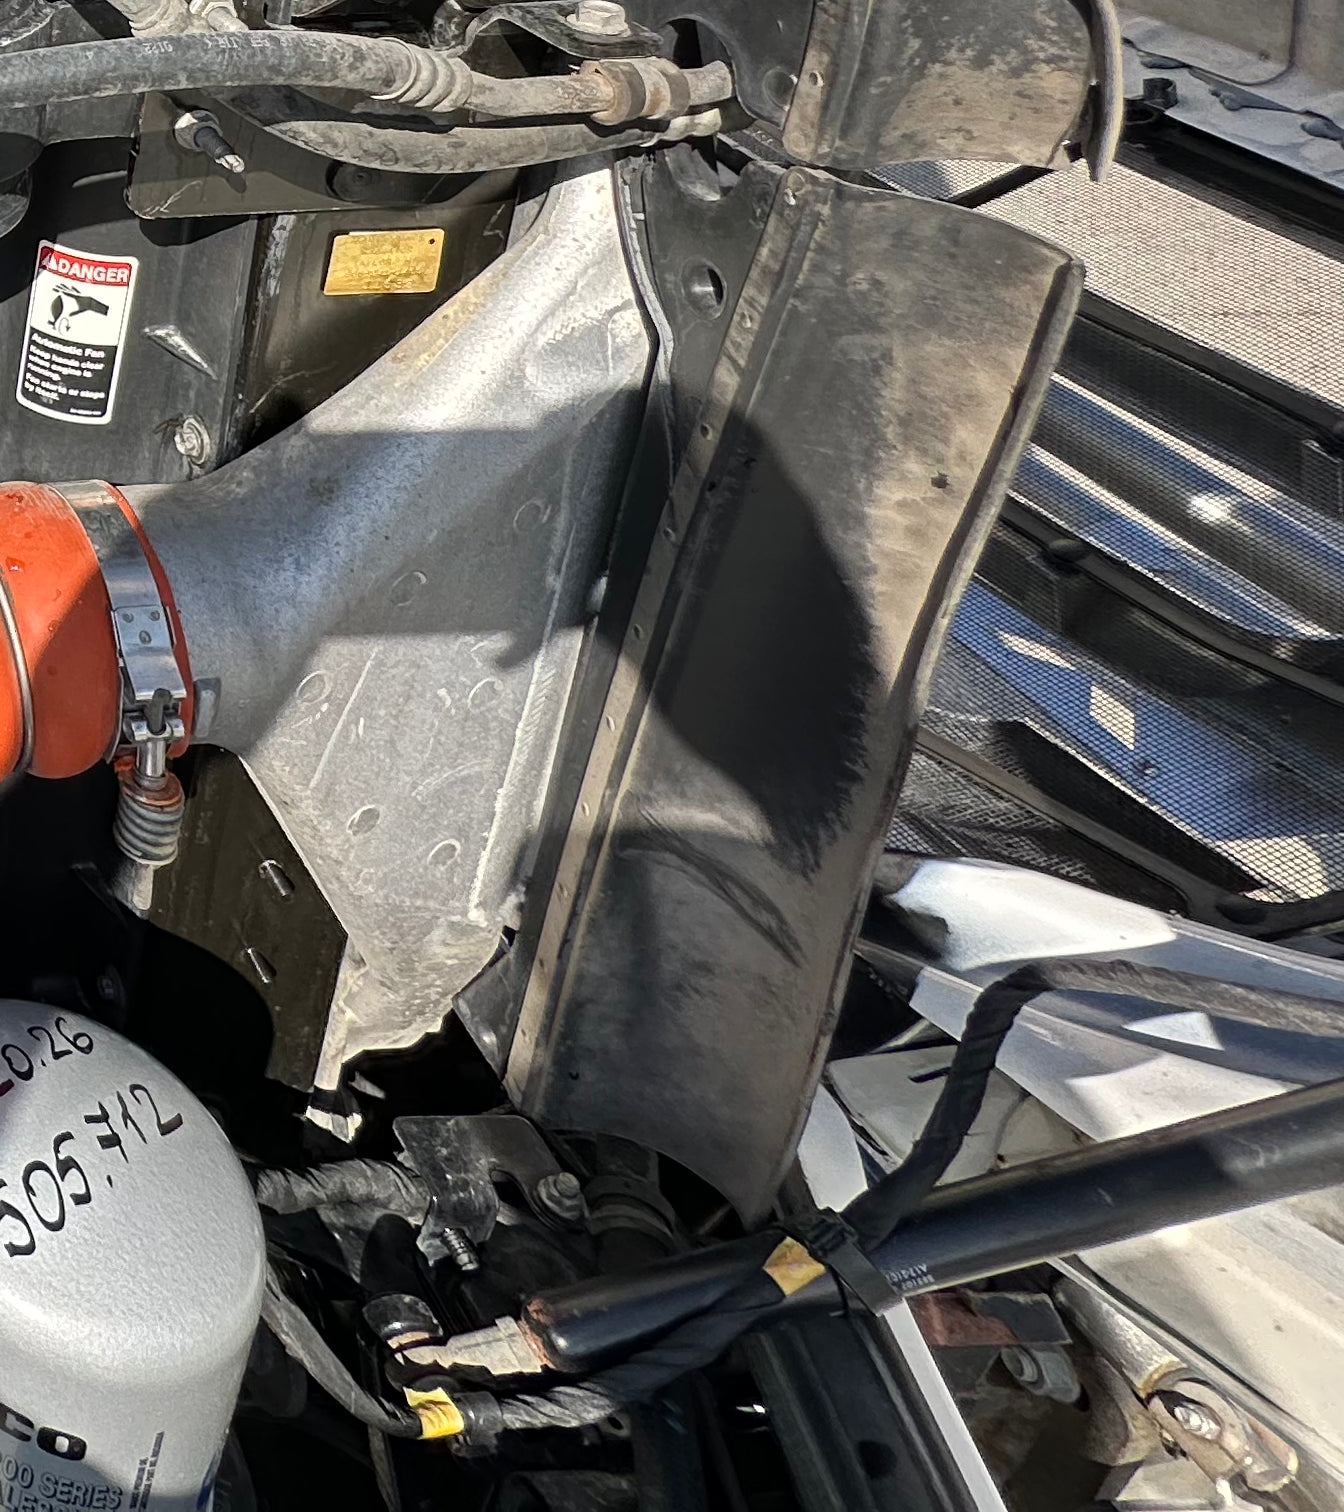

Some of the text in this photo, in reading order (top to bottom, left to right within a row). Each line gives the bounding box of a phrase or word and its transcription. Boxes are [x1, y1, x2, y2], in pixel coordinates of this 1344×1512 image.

[57, 259, 130, 283] DANGER
[31, 332, 105, 359] Automatic Fan
[81, 360, 105, 370] clear
[40, 1471, 125, 1510] SERIES
